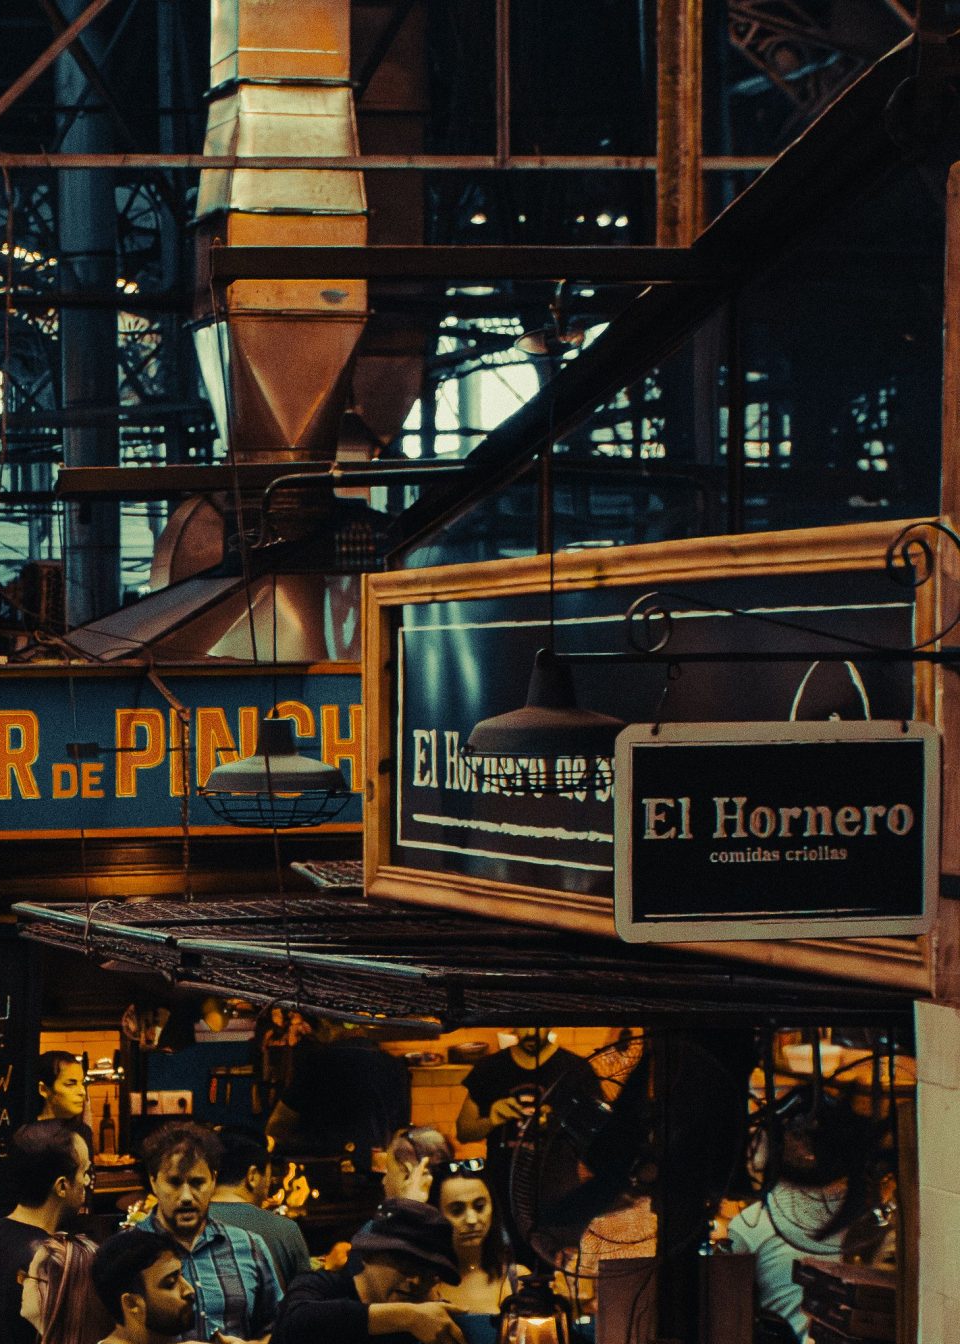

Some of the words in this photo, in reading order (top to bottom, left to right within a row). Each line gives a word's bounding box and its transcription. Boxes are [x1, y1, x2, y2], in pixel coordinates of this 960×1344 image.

[413, 728, 439, 788] El
[51, 763, 105, 799] DE
[641, 796, 694, 839] El
[712, 796, 914, 839] Hornero
[709, 847, 781, 863] comidas
[785, 846, 849, 861] criollas
